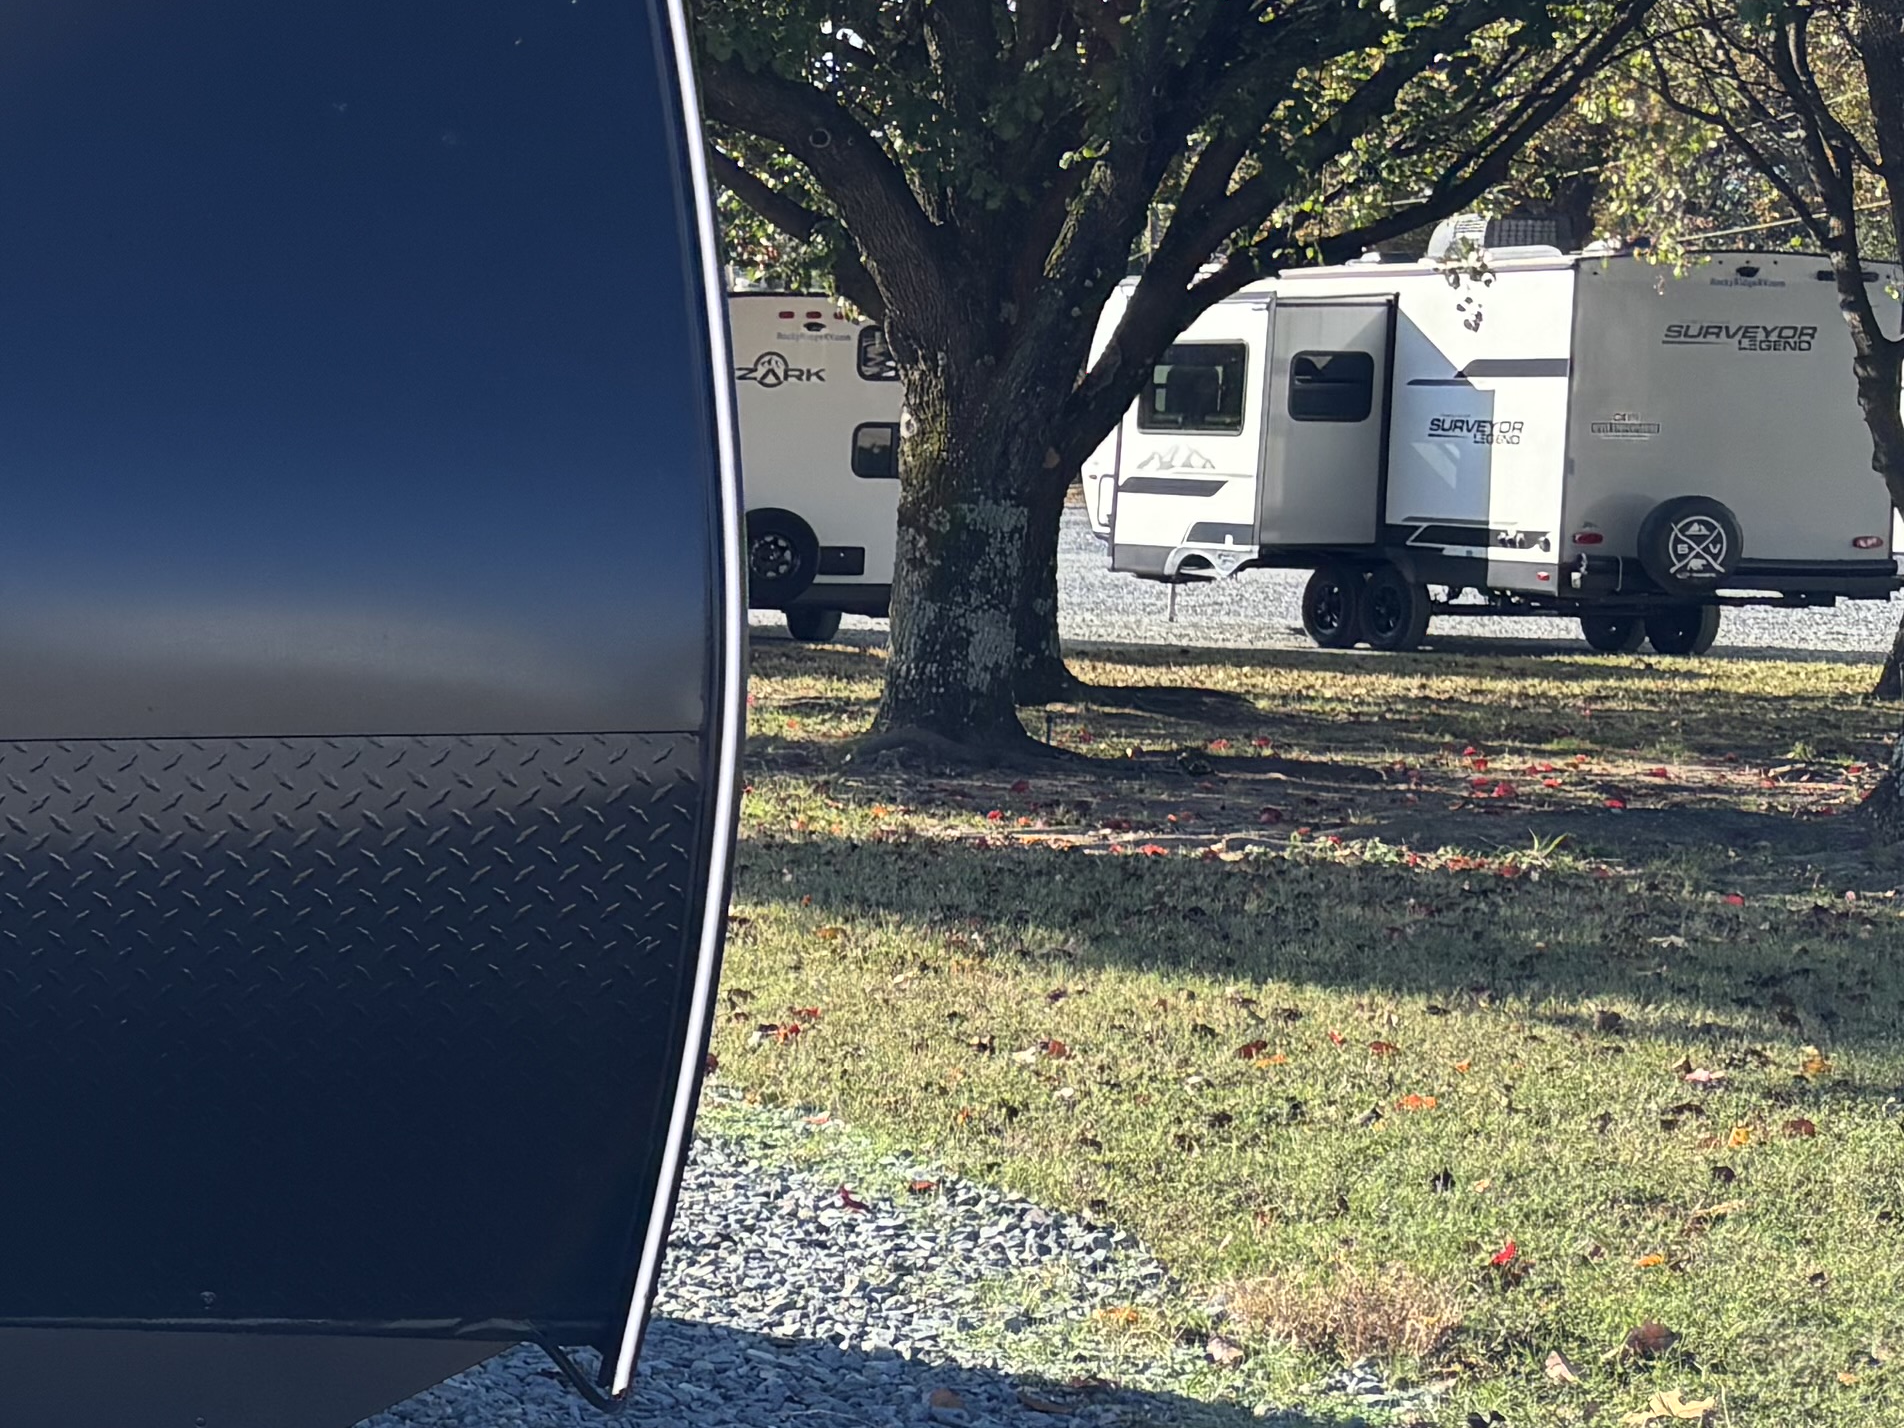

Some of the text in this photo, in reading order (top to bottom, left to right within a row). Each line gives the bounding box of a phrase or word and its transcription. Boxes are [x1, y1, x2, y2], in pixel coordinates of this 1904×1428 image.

[1664, 324, 1818, 340] SURVEYOR
[1738, 339, 1812, 352] LEGEND
[1429, 418, 1524, 433] SURVEYOR
[1708, 543, 1721, 554] V
